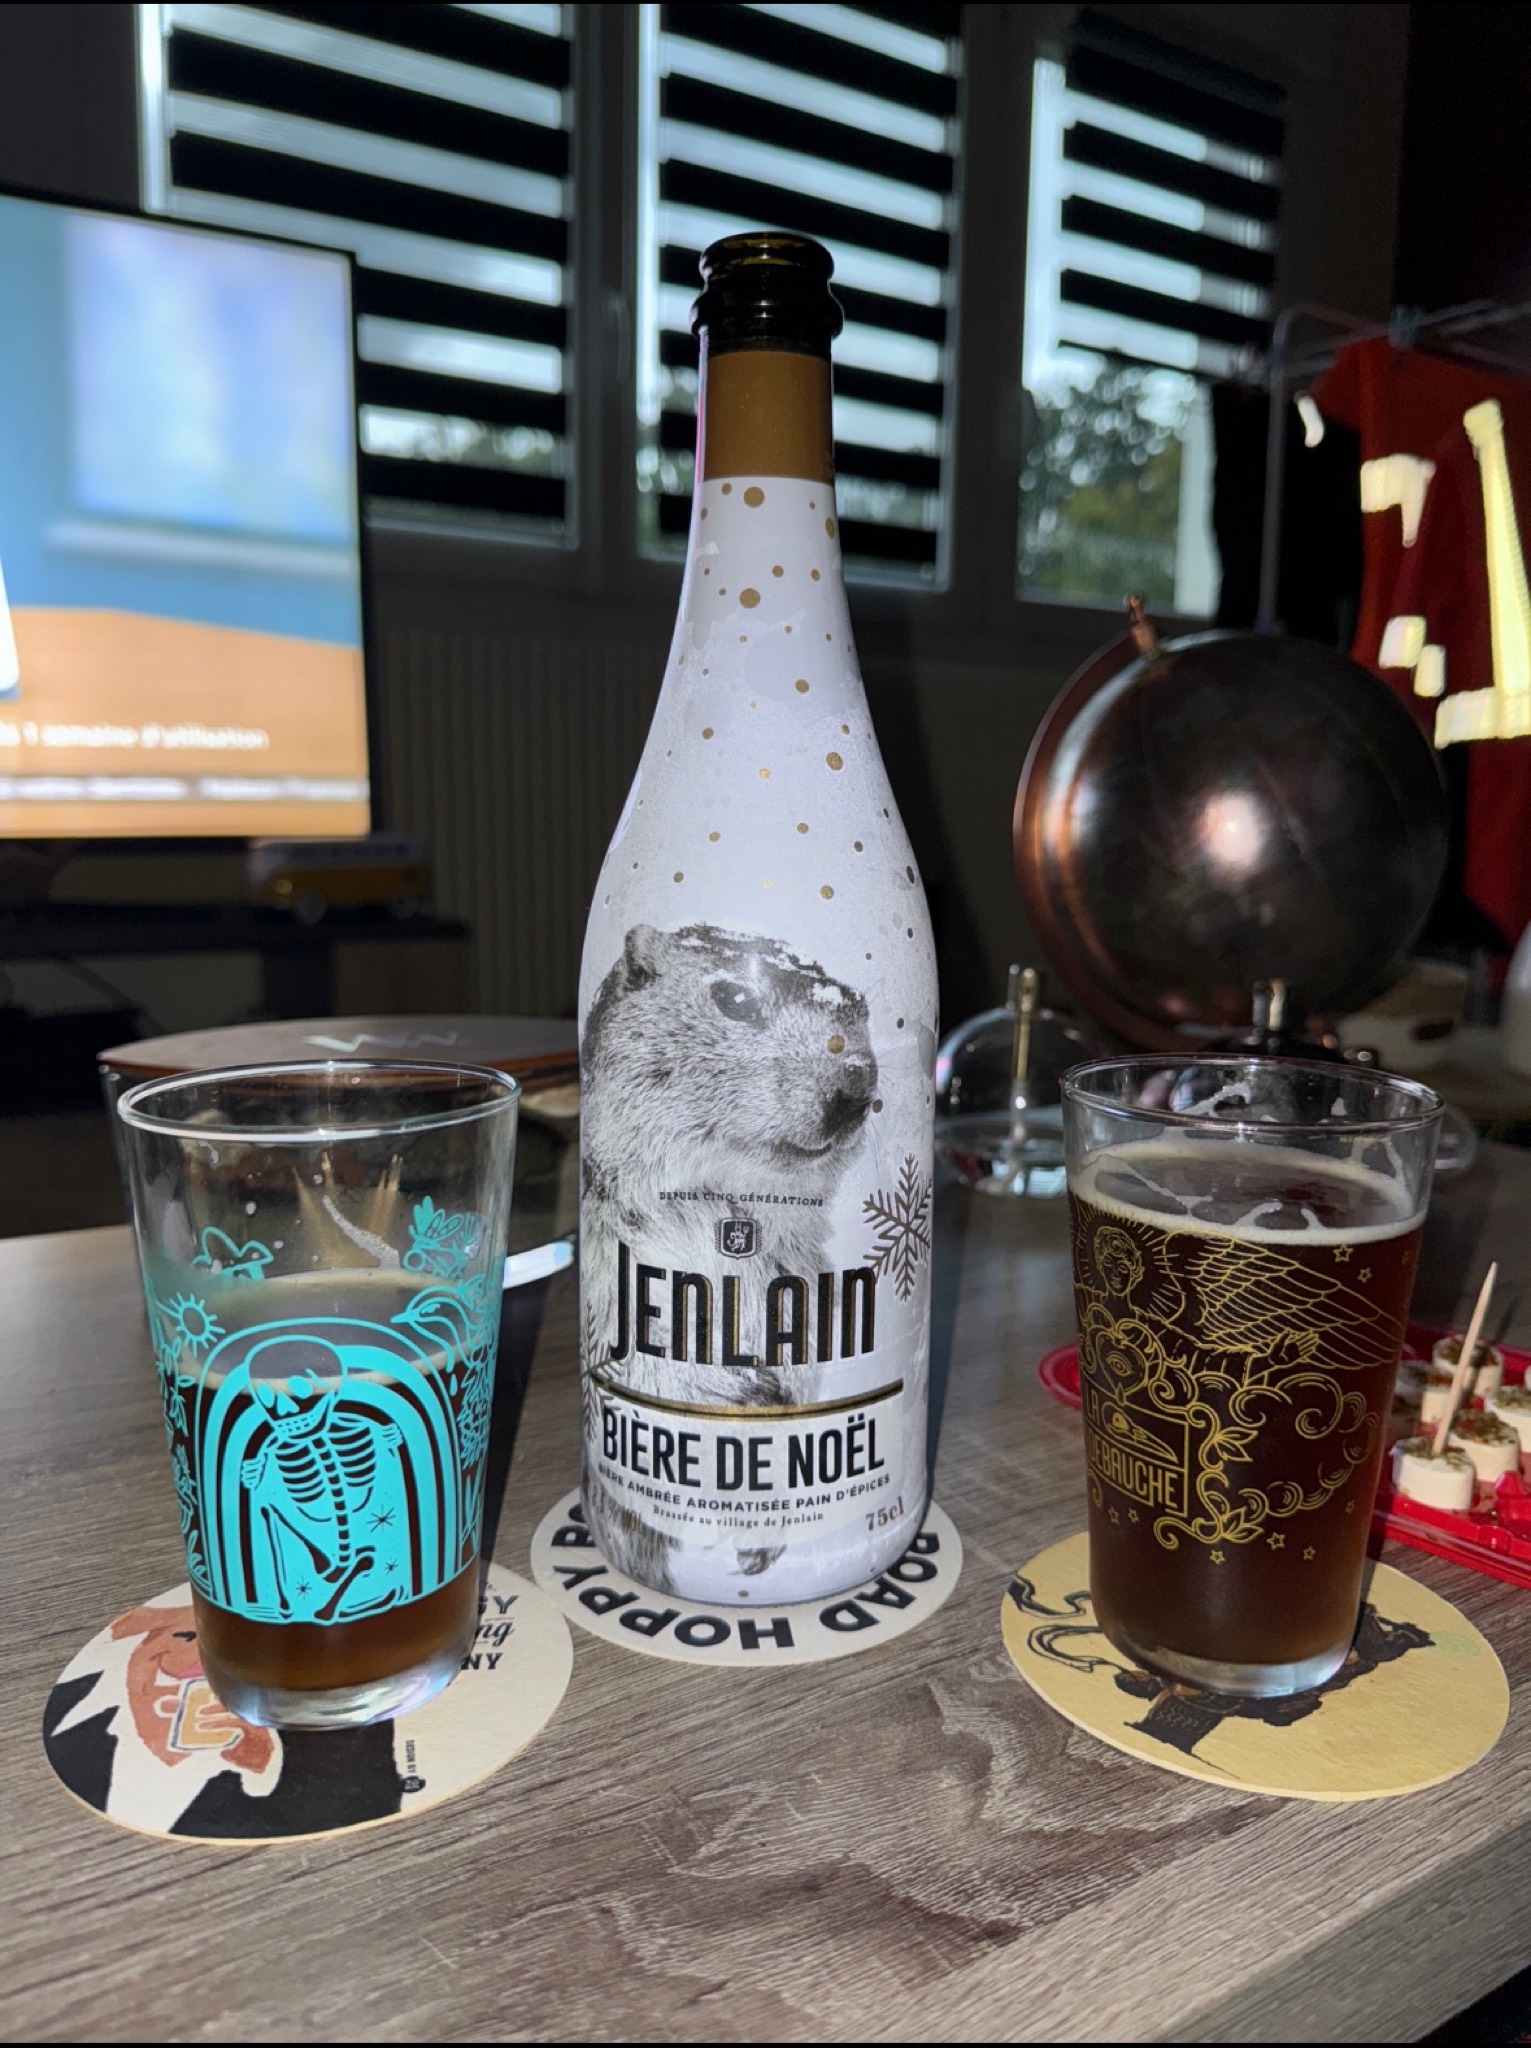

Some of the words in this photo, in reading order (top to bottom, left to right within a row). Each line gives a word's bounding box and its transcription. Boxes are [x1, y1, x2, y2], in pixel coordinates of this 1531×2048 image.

[659, 1191, 698, 1200] DEPUIS
[703, 1192, 738, 1204] CINQ
[739, 1192, 824, 1207] GÉNÉRATIONS
[603, 1404, 702, 1488] BIÈRE
[716, 1435, 774, 1491] DE
[788, 1412, 885, 1488] NOËL
[599, 1463, 624, 1485] BIÈRE
[627, 1480, 681, 1505] AMBRÉE
[686, 1497, 791, 1513] AROMATISÉE
[796, 1493, 831, 1509] PAIN
[835, 1473, 891, 1501] D'ÉPICES
[653, 1504, 695, 1523] Brassée
[699, 1516, 713, 1525] au
[717, 1516, 759, 1529] village
[764, 1516, 777, 1527] de
[781, 1512, 824, 1527] Jenlain
[865, 1496, 905, 1531] 75cl
[552, 1564, 796, 1651] HOPPY
